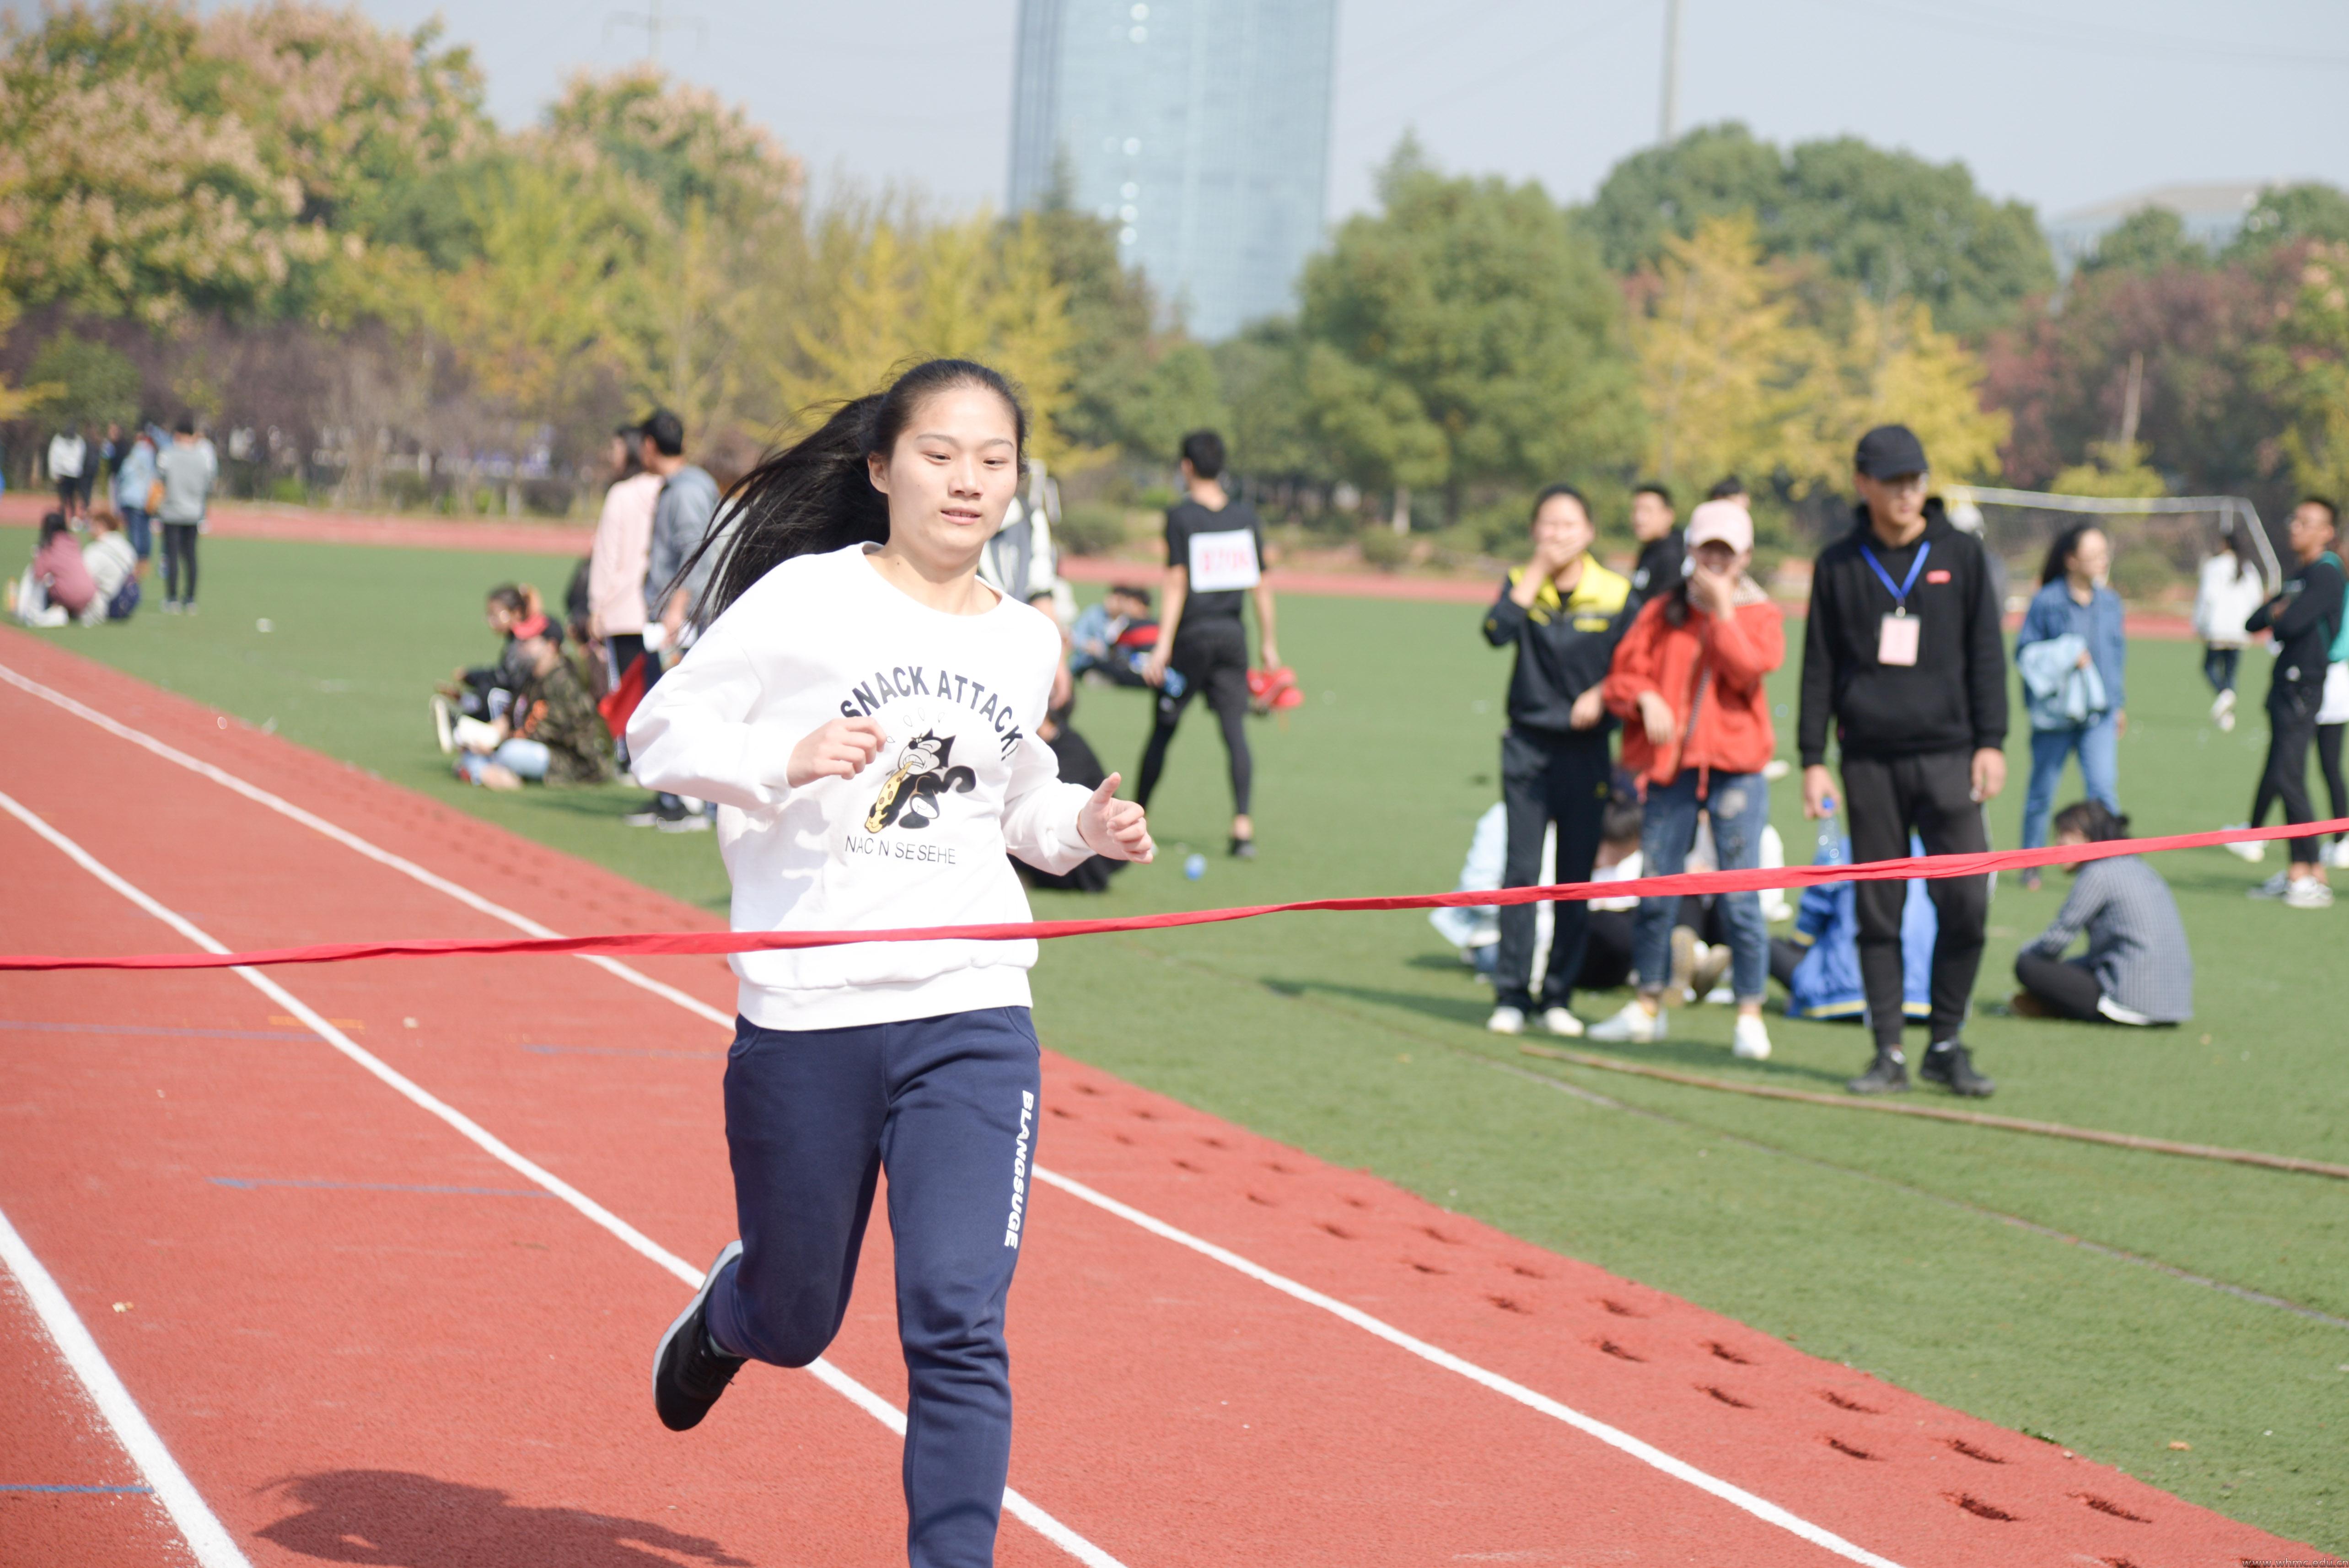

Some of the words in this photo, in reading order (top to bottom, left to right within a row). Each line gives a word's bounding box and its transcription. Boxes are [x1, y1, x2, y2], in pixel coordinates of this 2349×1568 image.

[840, 666, 930, 717] SNACK
[845, 835, 874, 854] NAC
[1004, 1090, 1034, 1250] BLANGSUGE
